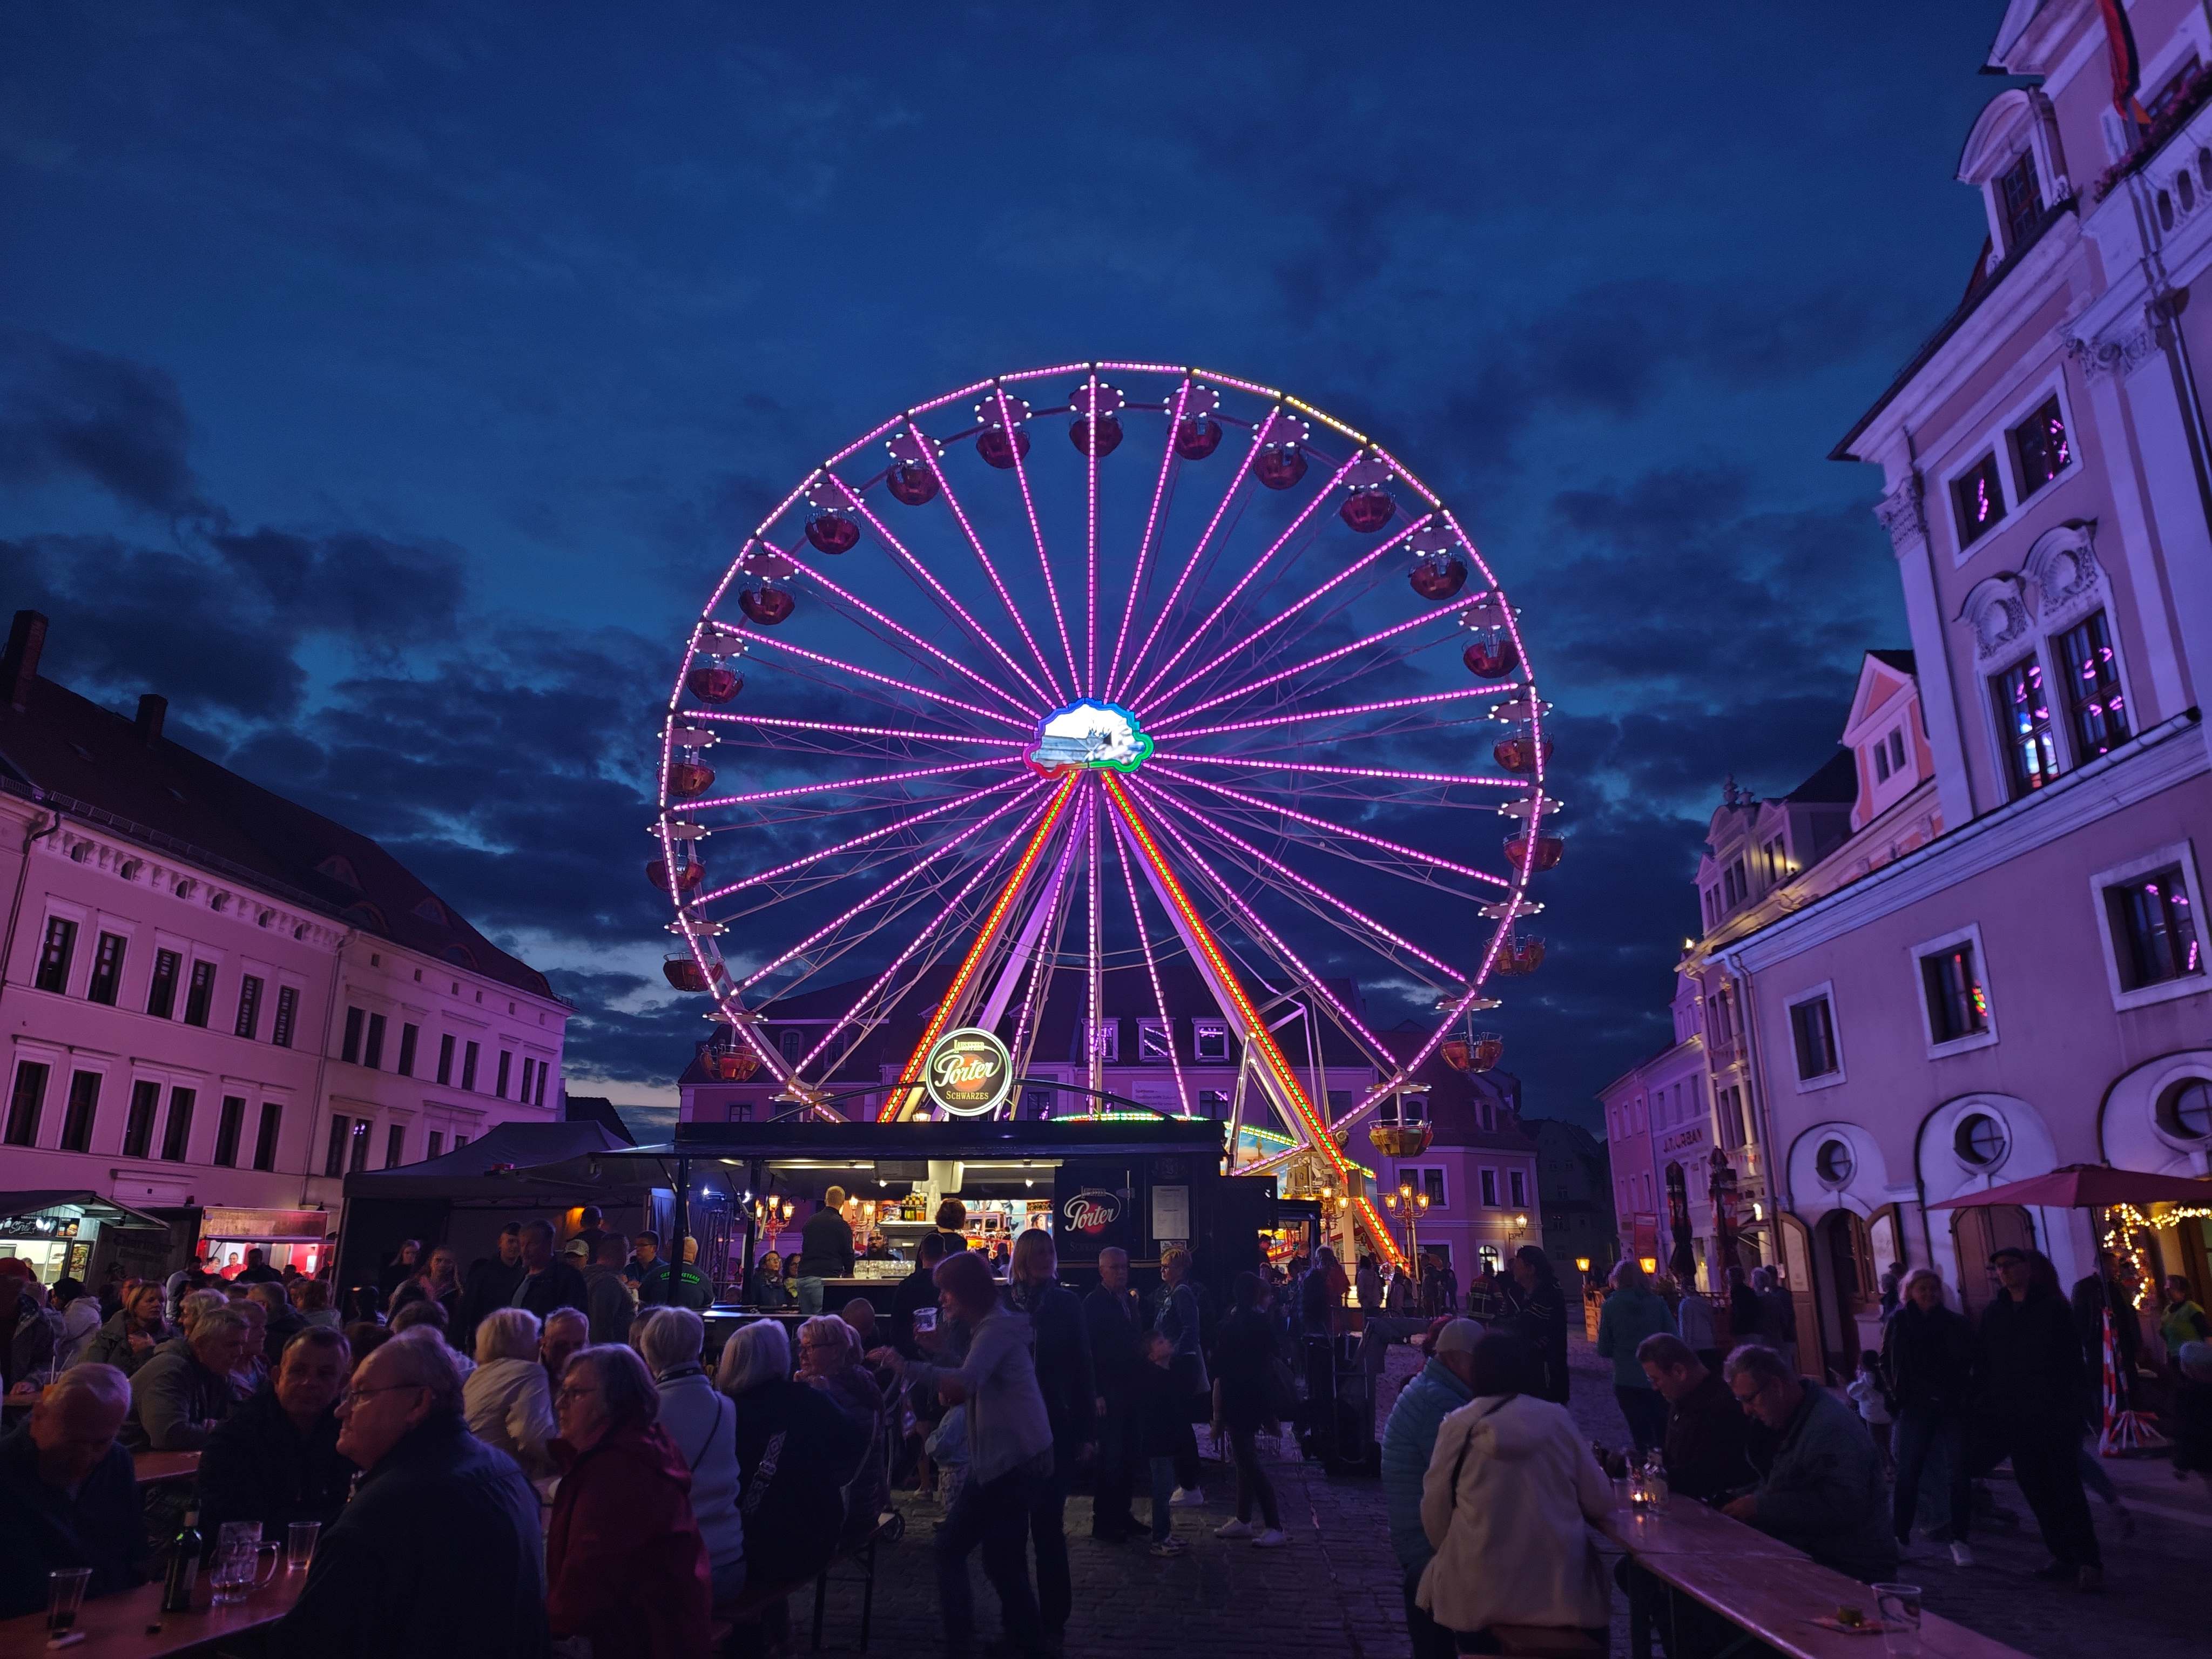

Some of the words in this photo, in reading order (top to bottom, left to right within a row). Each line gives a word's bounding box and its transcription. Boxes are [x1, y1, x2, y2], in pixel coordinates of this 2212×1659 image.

[934, 1053, 998, 1087] Porter
[946, 1091, 989, 1100] SCHWARZES
[1064, 1199, 1116, 1231] Porter
